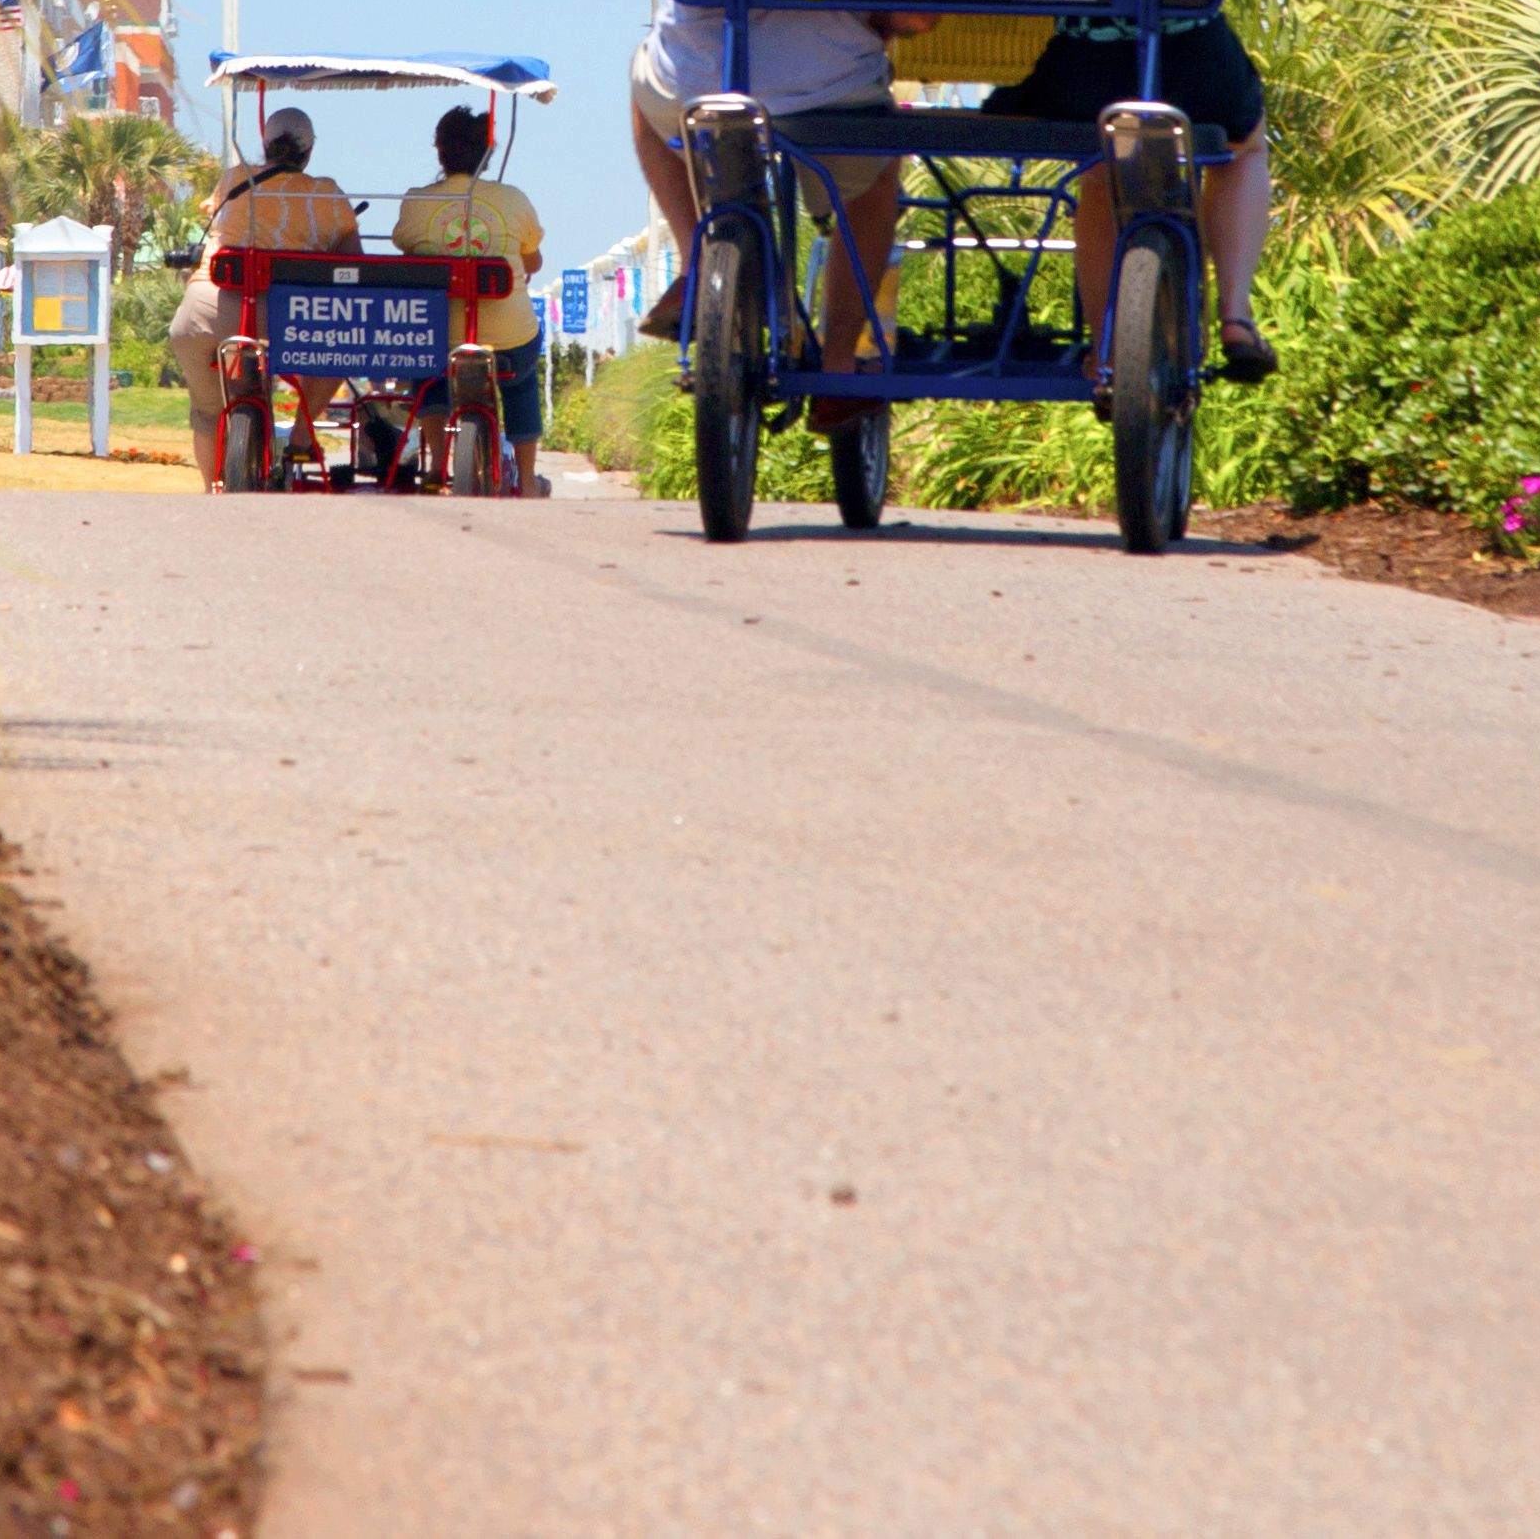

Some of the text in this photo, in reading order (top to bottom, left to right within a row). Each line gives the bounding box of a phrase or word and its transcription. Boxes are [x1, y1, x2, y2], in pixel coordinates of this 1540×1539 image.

[339, 271, 351, 280] 23
[289, 296, 428, 324] RENT ME
[284, 326, 434, 347] Seagull Motel
[282, 351, 437, 368] OCEANFRONT AT 27th ST.
